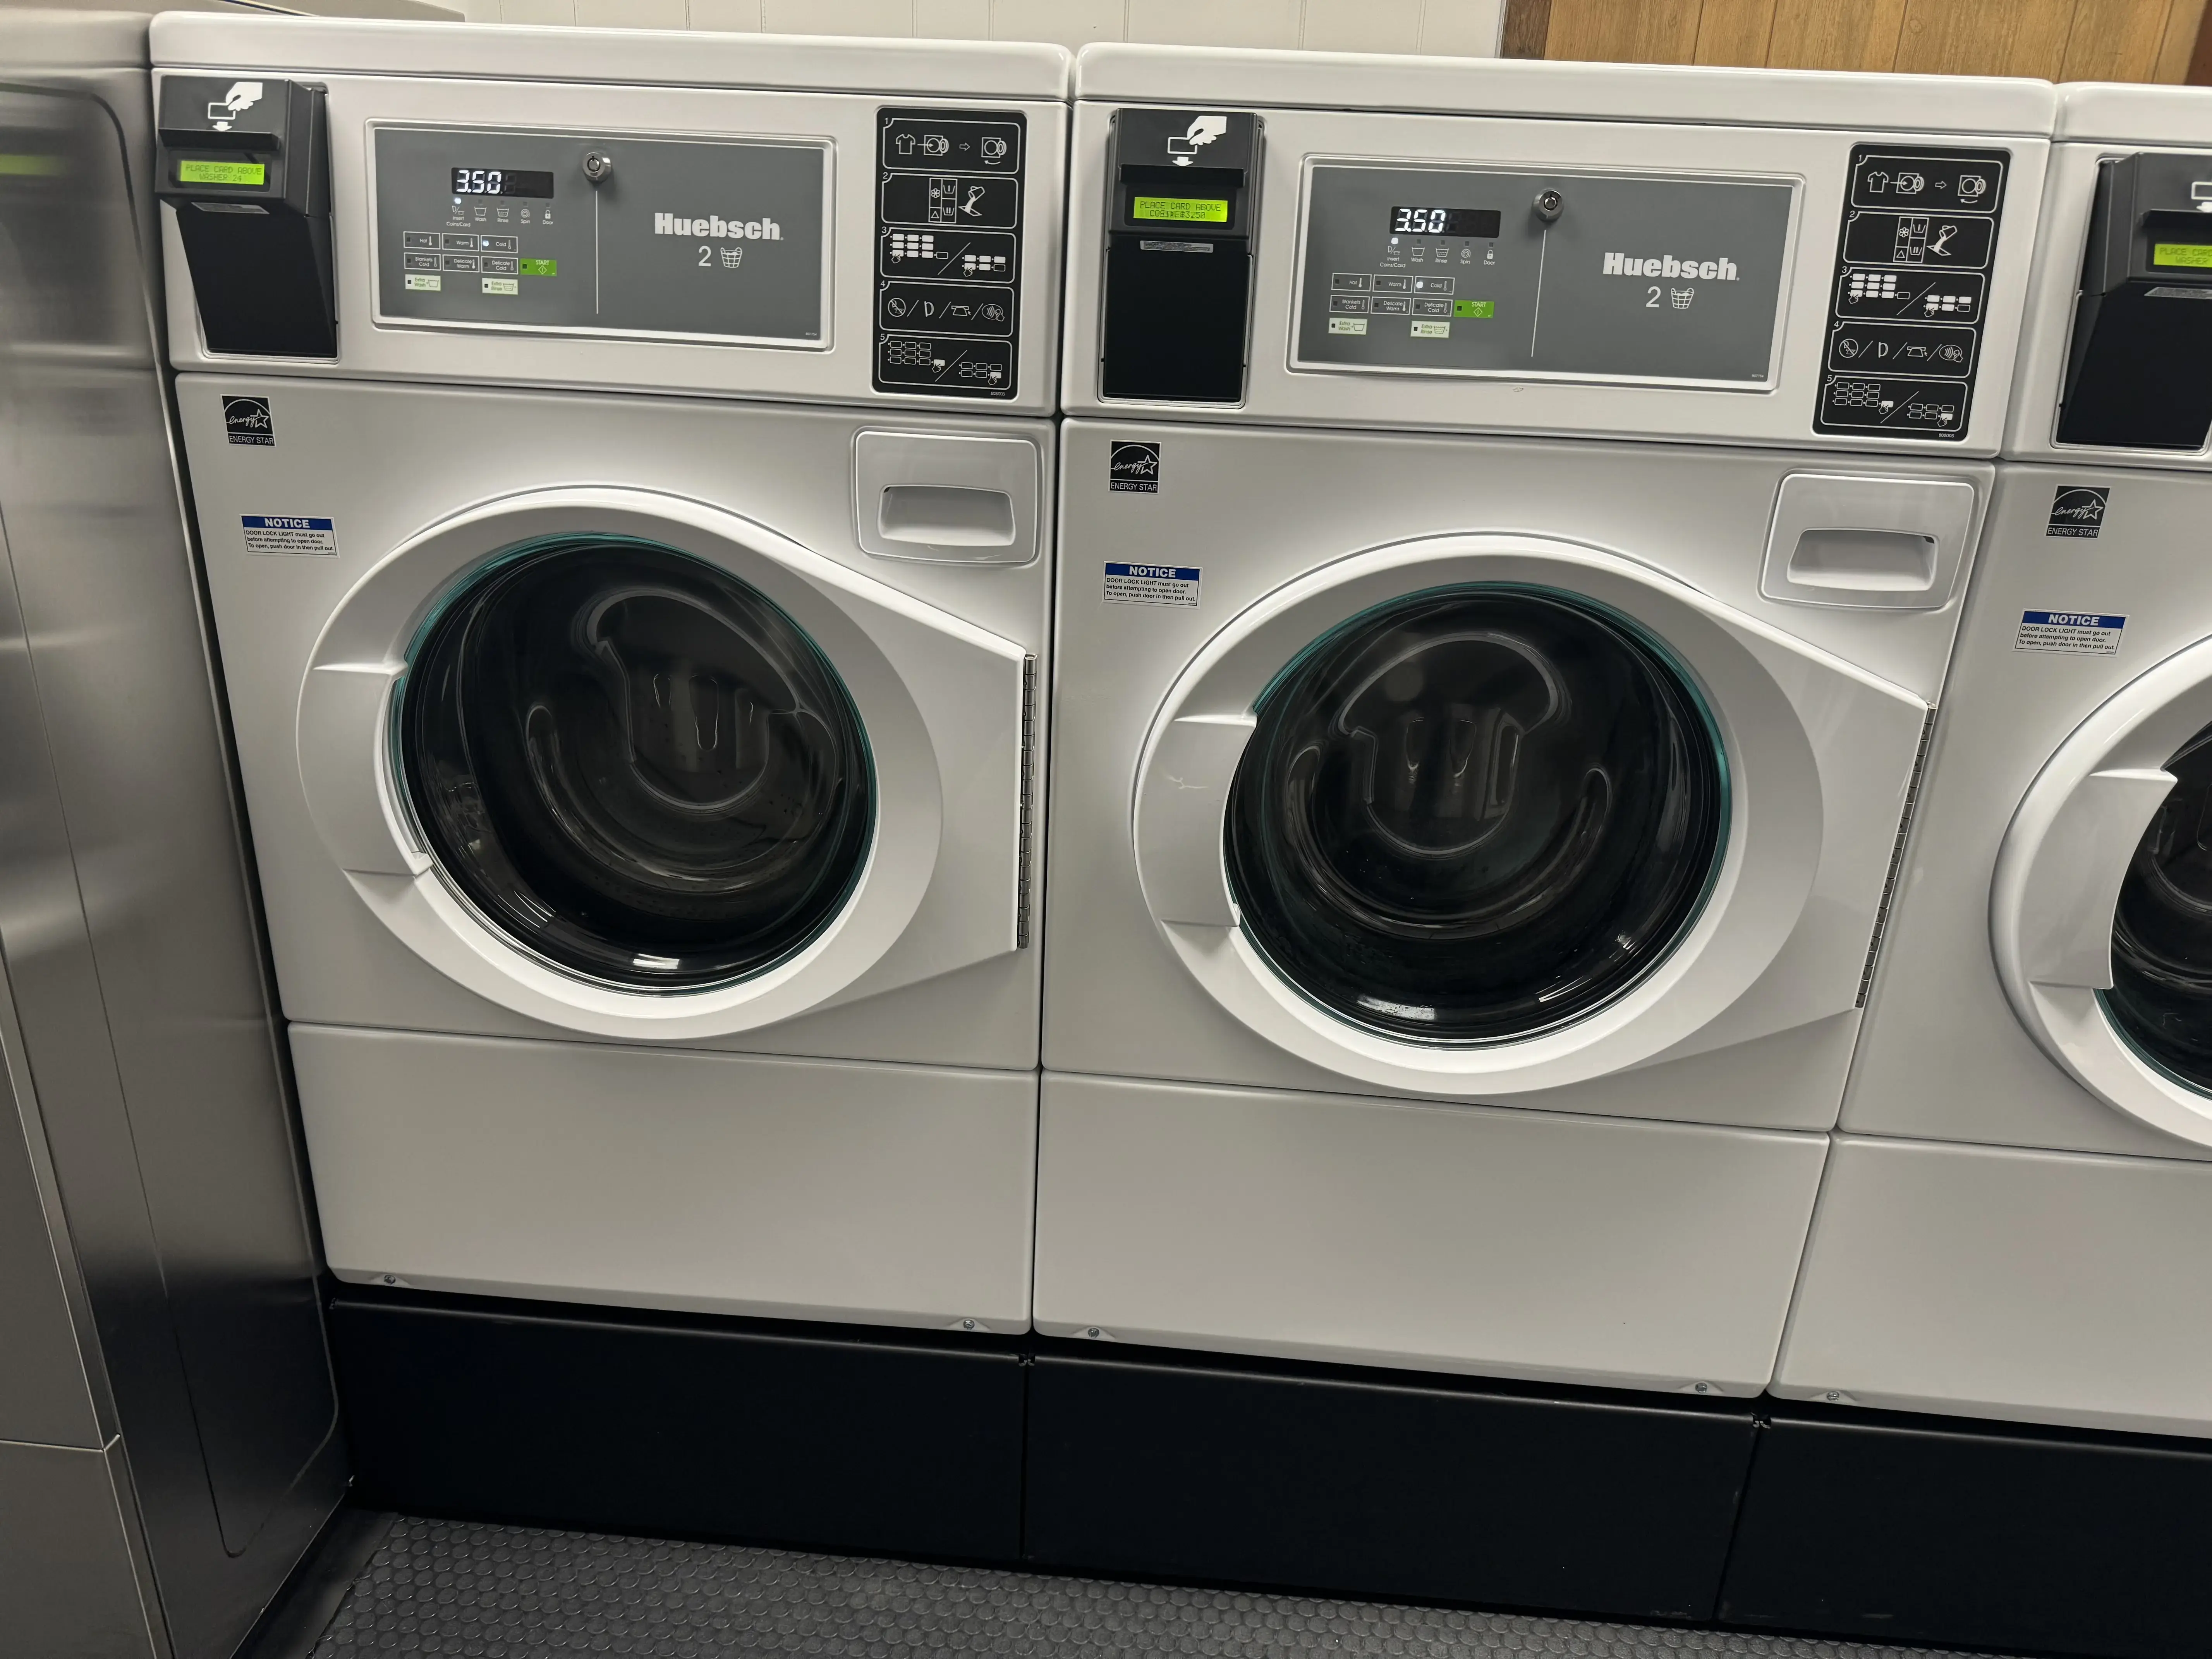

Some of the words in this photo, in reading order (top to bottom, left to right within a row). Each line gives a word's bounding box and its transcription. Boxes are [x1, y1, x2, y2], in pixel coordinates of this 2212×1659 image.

[457, 170, 501, 194] 3.50
[655, 213, 780, 240] Huebsch
[1395, 208, 1446, 233] 3.50
[698, 246, 711, 266] 2
[2160, 247, 2187, 256] PLACE
[2176, 256, 2208, 264] WASHER
[1603, 252, 1737, 280] Huebsch
[1646, 286, 1661, 307] 2
[264, 518, 310, 528] NOTICE
[1129, 566, 1176, 578] NOTICE
[2048, 614, 2100, 626] NOTICE
